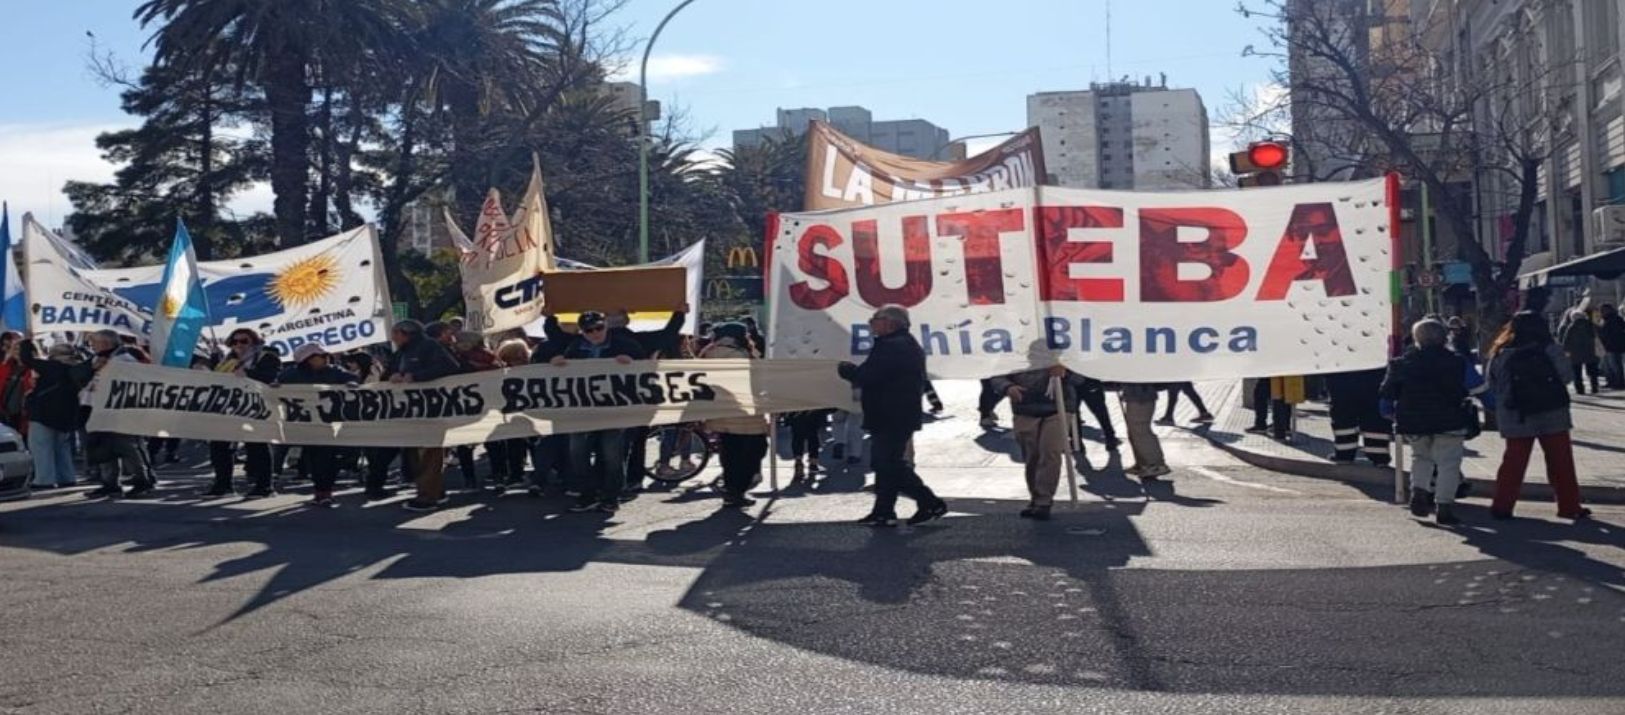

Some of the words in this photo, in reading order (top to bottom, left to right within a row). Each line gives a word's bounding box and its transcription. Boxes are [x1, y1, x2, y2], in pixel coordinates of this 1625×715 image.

[822, 145, 874, 206] LA
[788, 203, 1358, 310] SUTEBA
[41, 304, 132, 329] BAHIA
[62, 291, 131, 309] CENTRAL
[270, 319, 376, 358] ORREGO
[277, 308, 355, 334] ARGENTINA
[851, 319, 1013, 356] Bhía
[1044, 317, 1258, 354] Blanca
[104, 379, 272, 421] MULTISECTORIAL
[279, 397, 312, 422] DE
[316, 383, 485, 423] JUBILADXS
[501, 372, 716, 414] BAHIENSES
